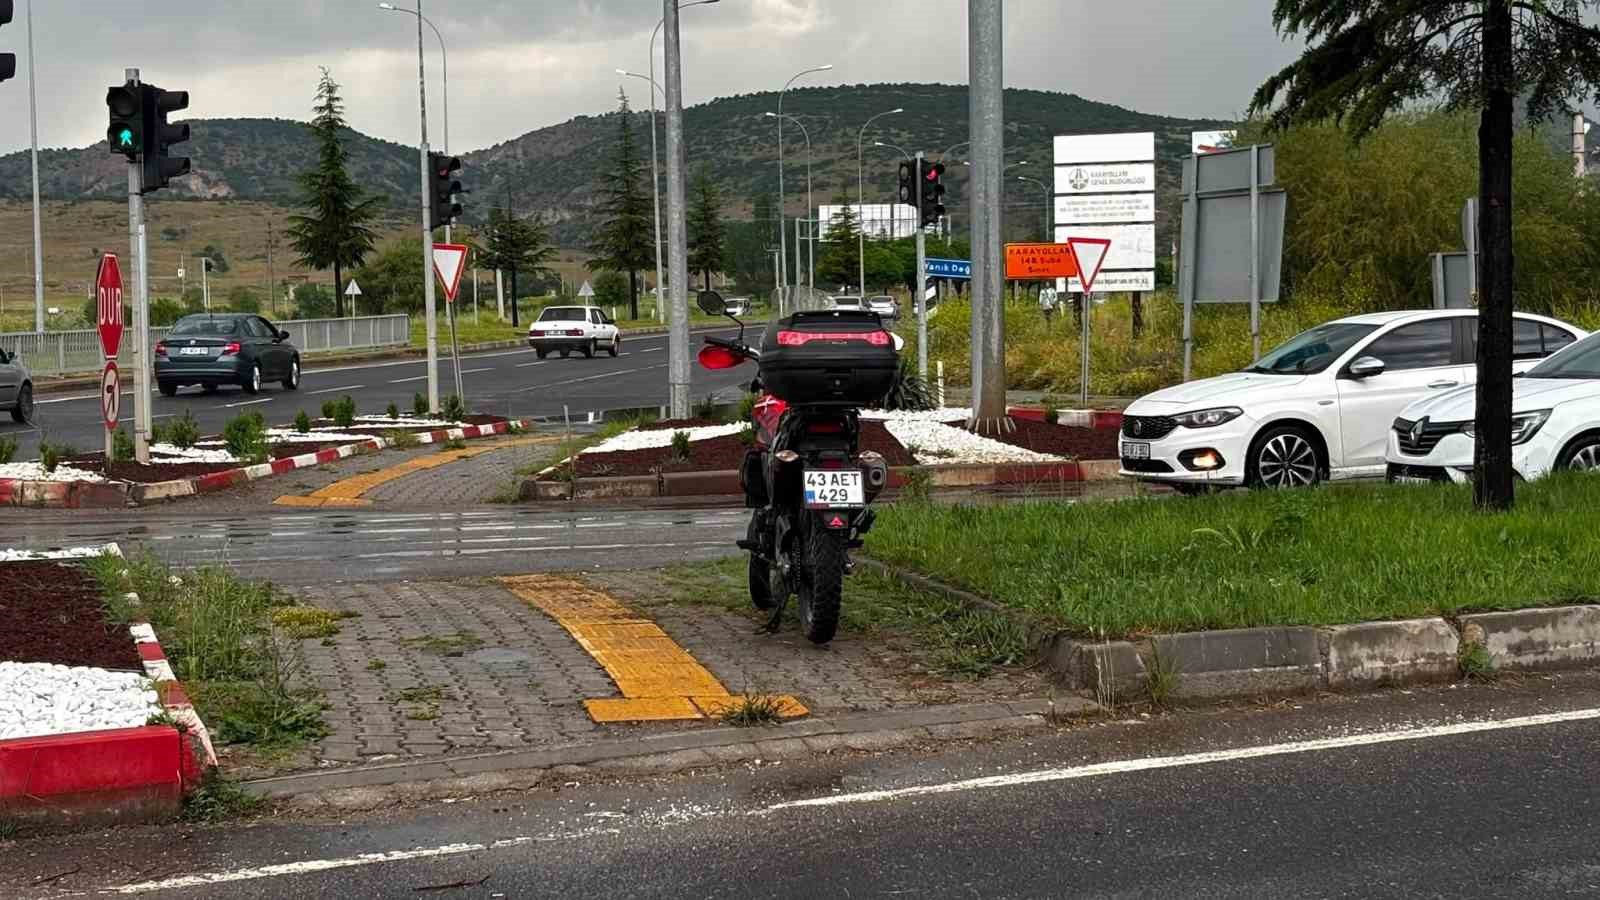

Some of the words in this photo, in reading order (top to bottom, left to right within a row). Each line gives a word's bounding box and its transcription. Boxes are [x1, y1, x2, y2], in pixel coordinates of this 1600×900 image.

[1009, 247, 1070, 255] KARAYOLLAR
[100, 287, 122, 325] DUR
[807, 473, 827, 487] 43
[830, 473, 860, 487] AET
[818, 488, 848, 502] 429
